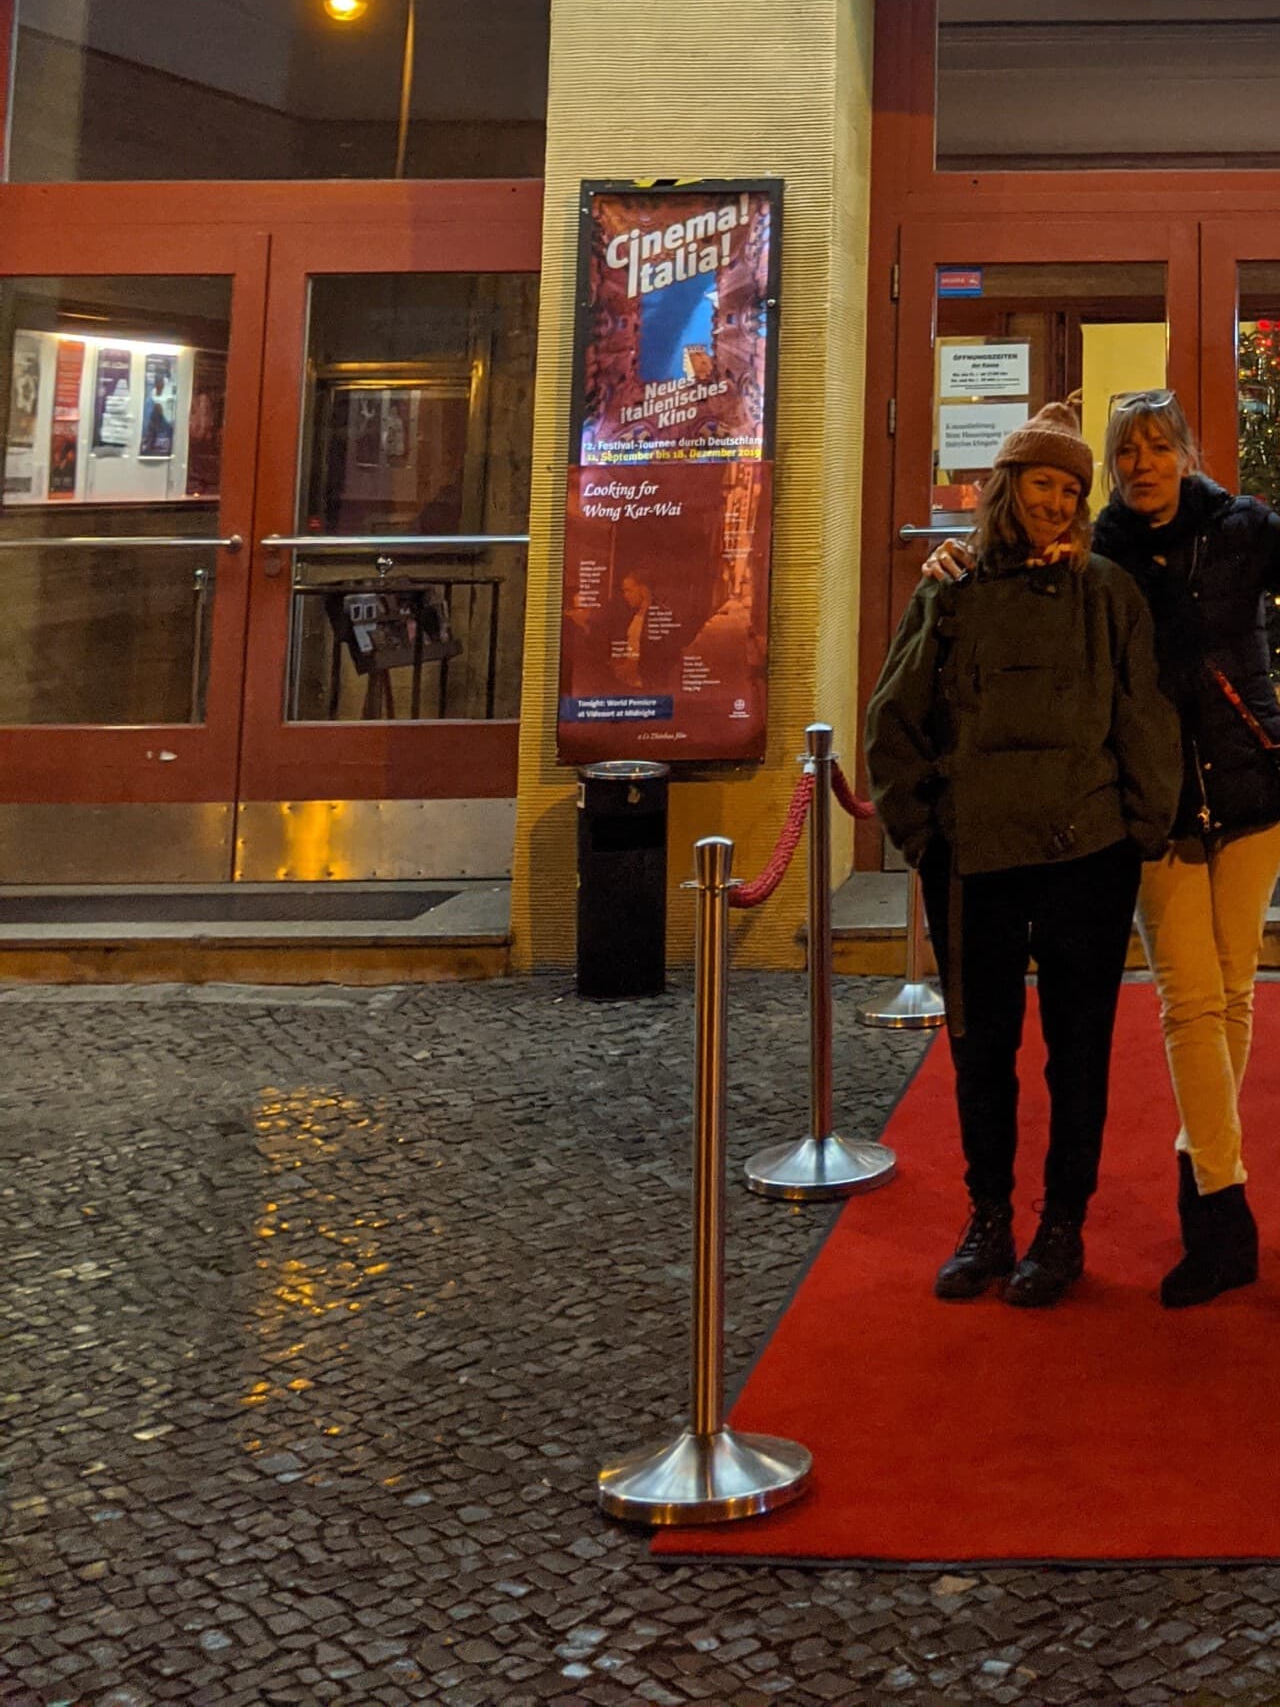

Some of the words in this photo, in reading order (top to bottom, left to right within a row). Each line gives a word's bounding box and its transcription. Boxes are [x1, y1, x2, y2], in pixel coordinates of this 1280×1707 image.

[606, 192, 750, 274] Cinema!
[627, 232, 731, 299] Italia!
[644, 373, 697, 401] Neues
[657, 406, 698, 430] Kino
[598, 439, 677, 451] Festival-Tournee
[678, 437, 706, 447] durch
[708, 435, 763, 446] Deutschlan
[600, 450, 654, 464] September
[656, 449, 670, 460] bis
[689, 448, 736, 458] Dezember
[738, 448, 762, 458] 2019
[583, 480, 636, 500] Looking
[634, 480, 660, 500] for
[583, 502, 622, 522] Wong
[623, 501, 682, 520] Kar-Wai
[606, 699, 628, 708] World
[624, 708, 656, 719] Midnight
